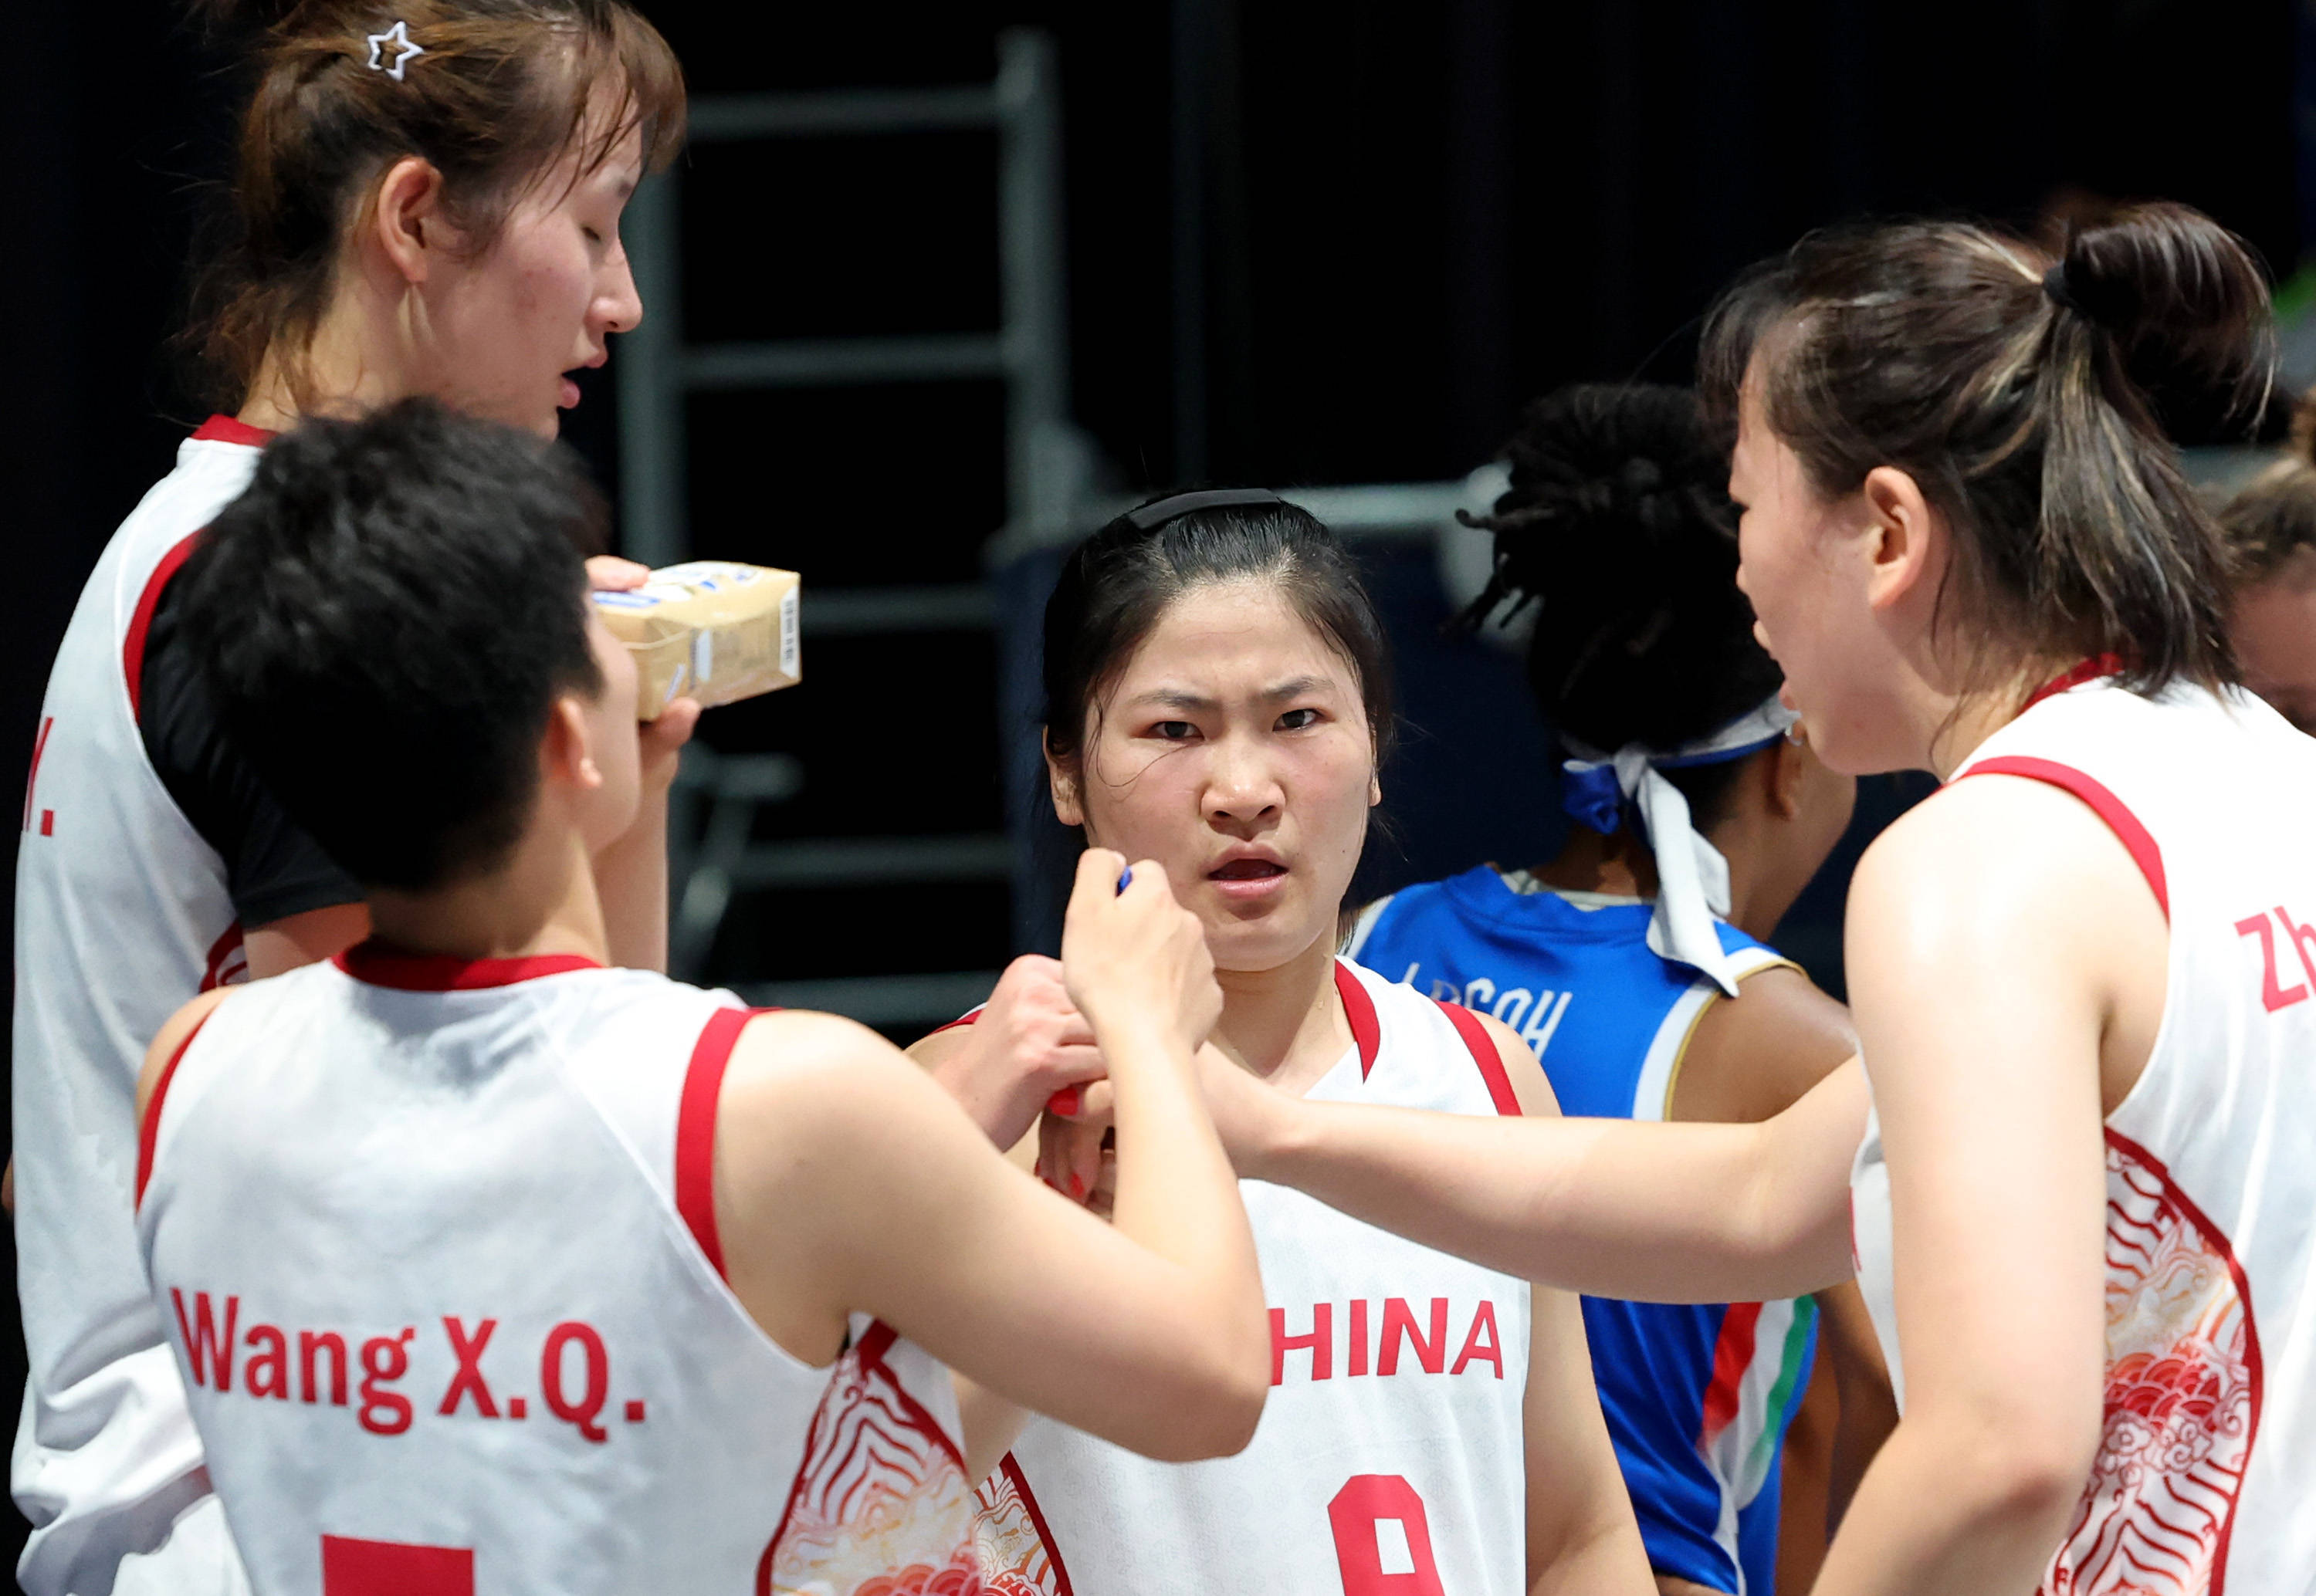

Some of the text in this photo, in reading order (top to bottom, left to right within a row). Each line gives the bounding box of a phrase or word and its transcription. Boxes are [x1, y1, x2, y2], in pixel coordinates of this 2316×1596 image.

[170, 1287, 645, 1443] Wang X.Q.
[1268, 1297, 1504, 1386] HINA
